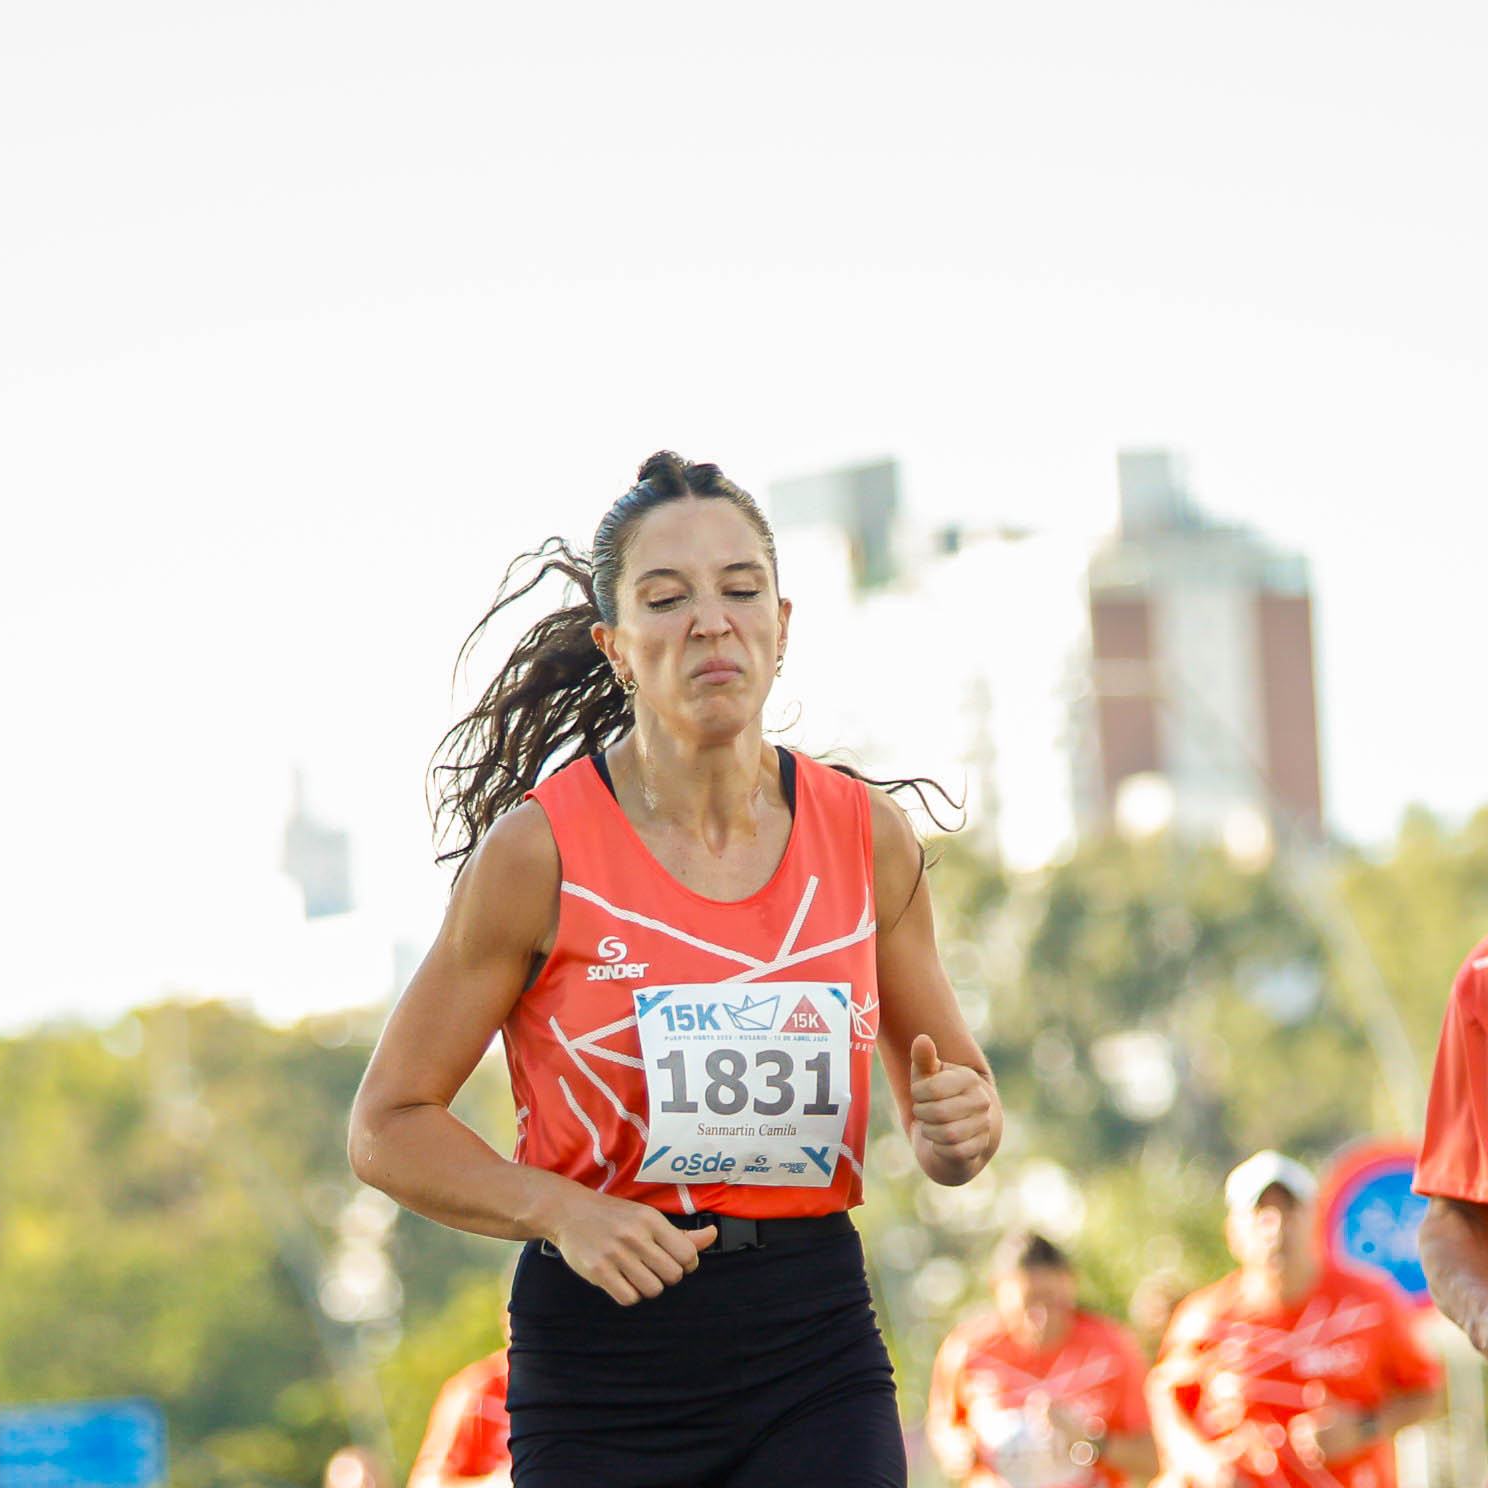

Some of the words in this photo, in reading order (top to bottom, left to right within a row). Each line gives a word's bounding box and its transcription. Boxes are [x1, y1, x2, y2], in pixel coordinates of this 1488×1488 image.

[660, 1003, 722, 1031] 15K
[791, 1013, 821, 1028] 15K
[657, 1049, 840, 1116] 1831
[697, 1123, 755, 1137] Sanmartin
[759, 1123, 797, 1137] Camila
[671, 1152, 736, 1174] osde
